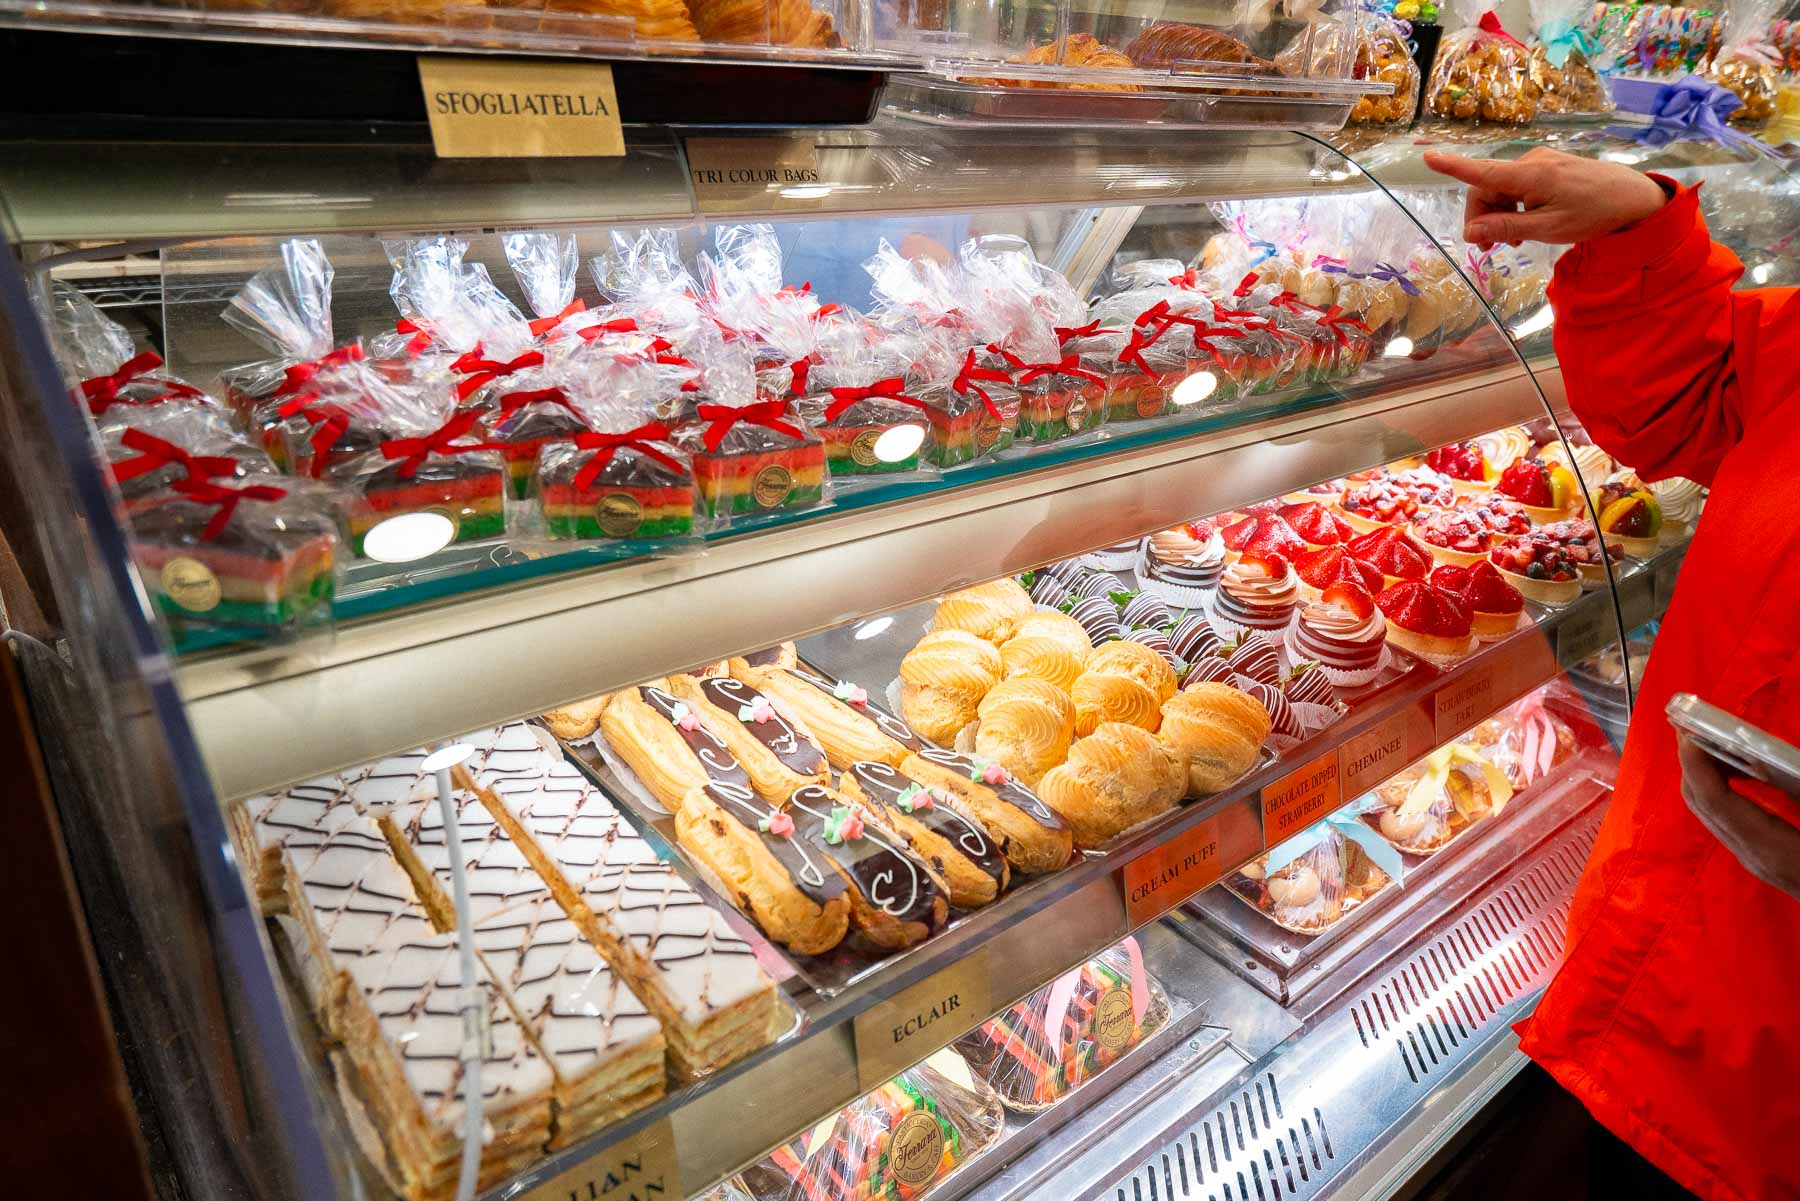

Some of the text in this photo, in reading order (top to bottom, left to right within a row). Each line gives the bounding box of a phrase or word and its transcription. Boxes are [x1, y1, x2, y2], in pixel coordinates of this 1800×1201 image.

[435, 92, 610, 117] SFOGLIATELLA
[695, 167, 818, 184] TRI COLOR BAGS
[1346, 736, 1403, 778] CHEMINEE
[1264, 764, 1338, 816] CHOCOLATE DIPPED
[1278, 791, 1327, 830] STRAWBERRY
[1131, 841, 1217, 904] CREAM PUFF
[892, 994, 961, 1044] ECLAIR
[894, 1128, 937, 1172] Ferrara
